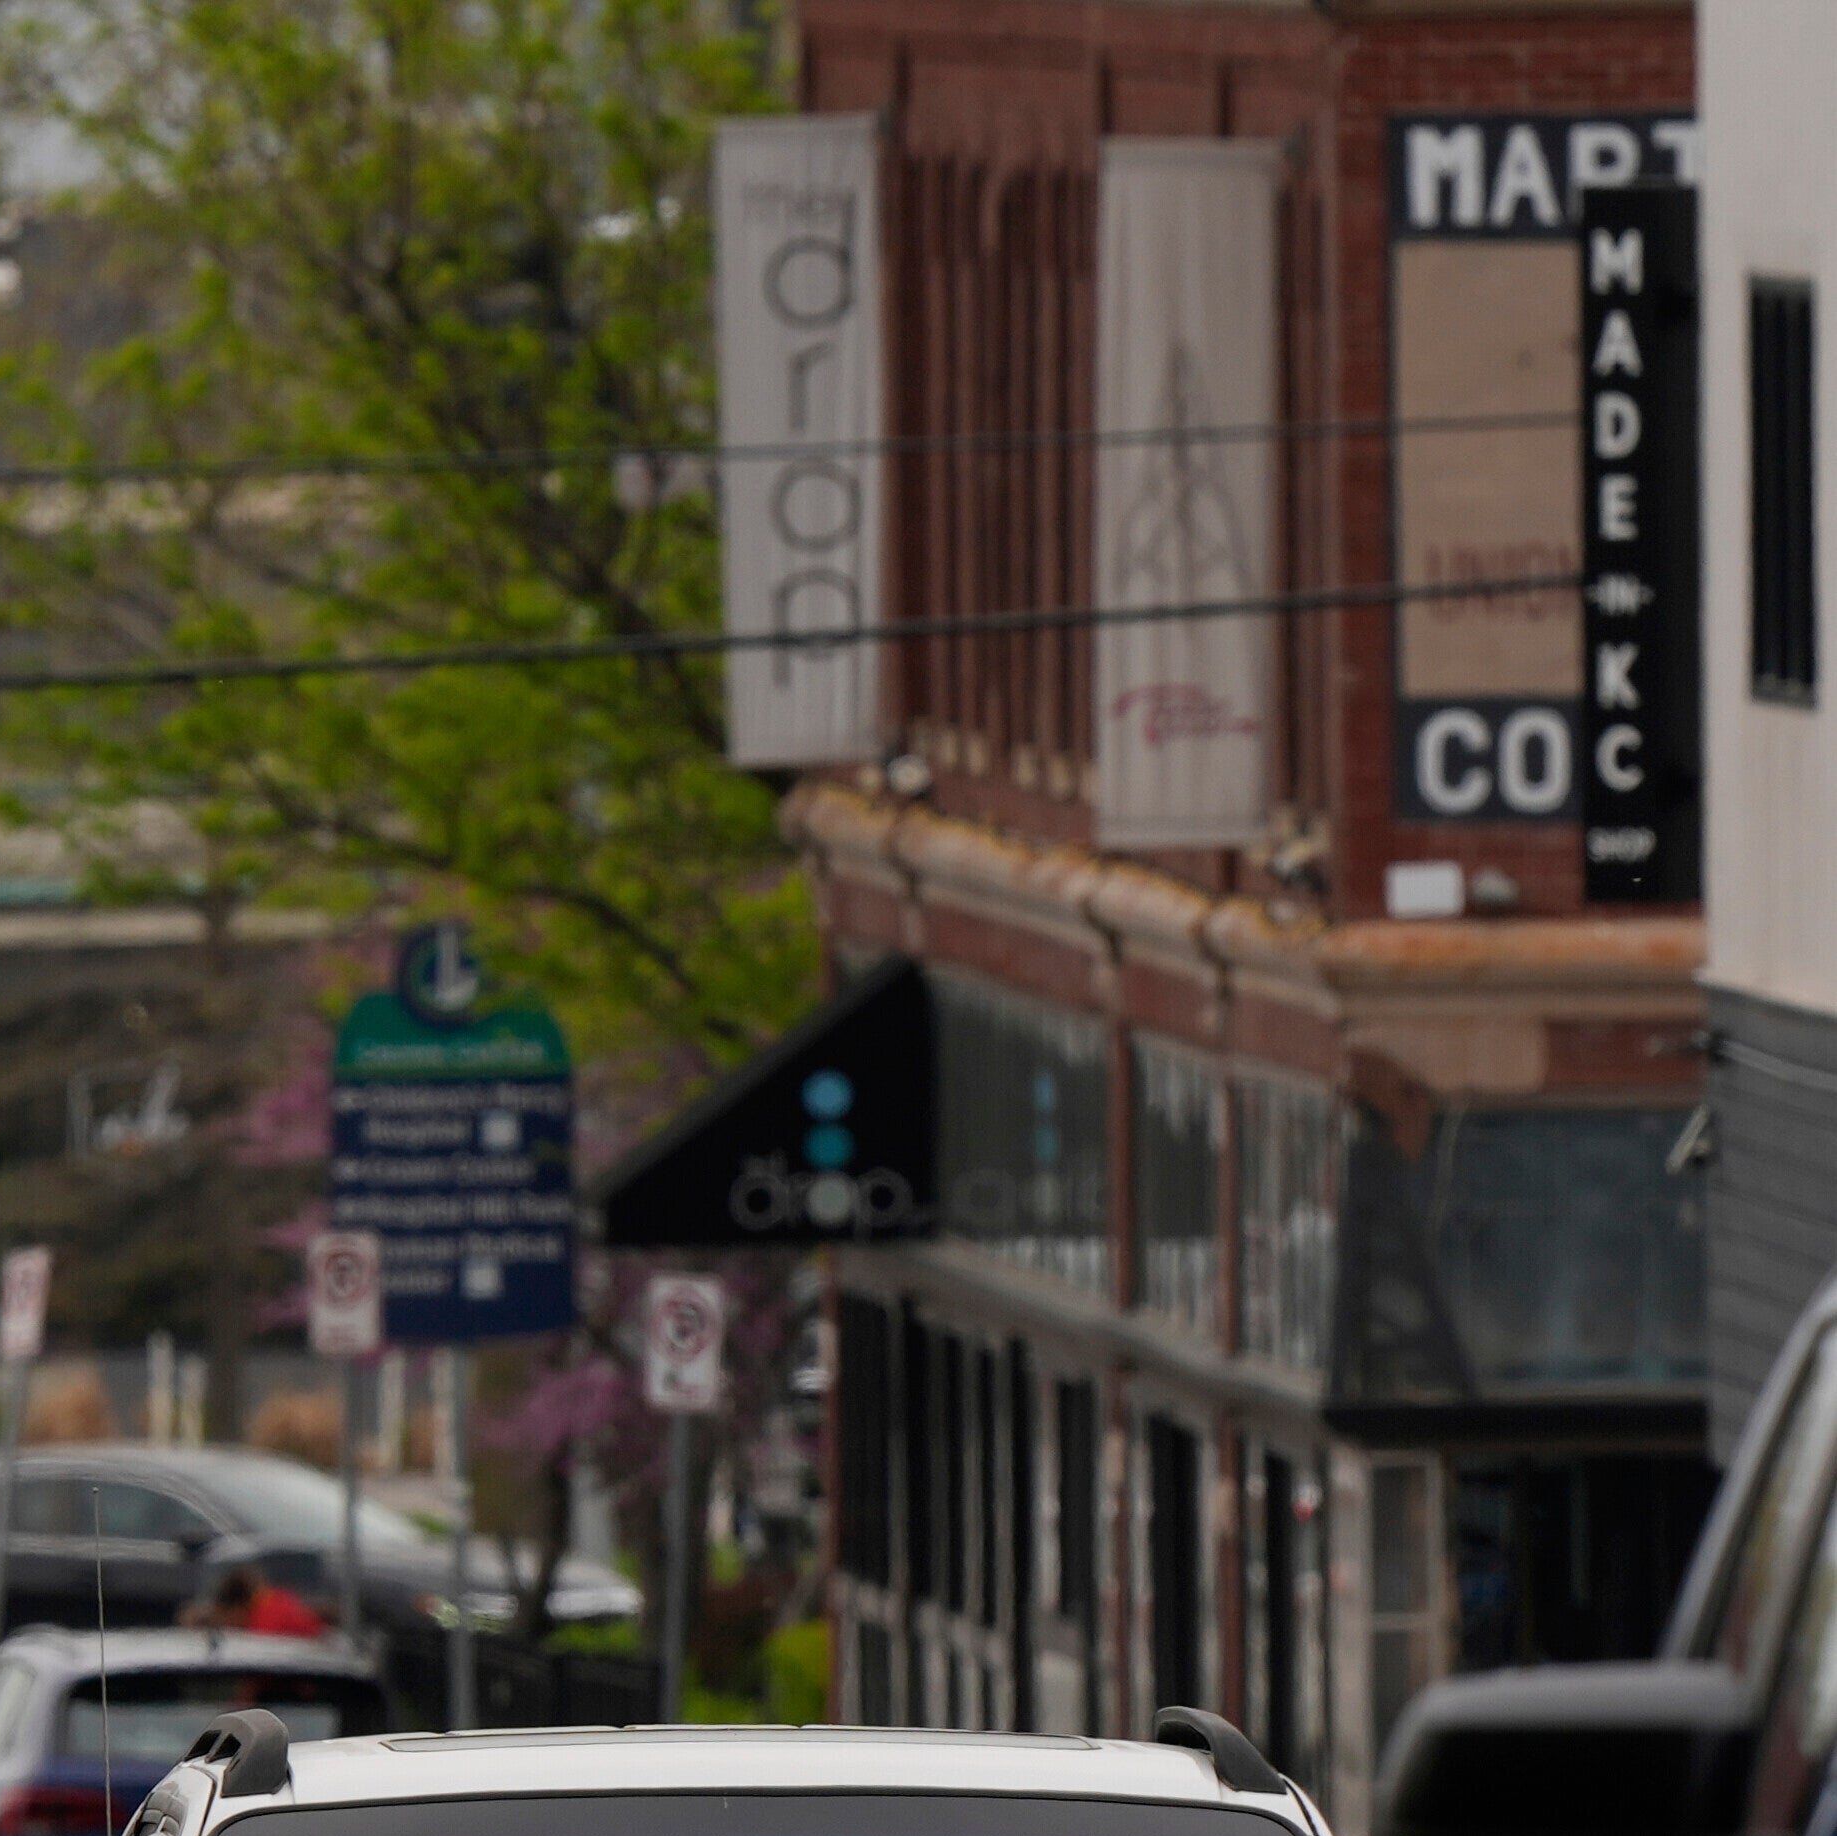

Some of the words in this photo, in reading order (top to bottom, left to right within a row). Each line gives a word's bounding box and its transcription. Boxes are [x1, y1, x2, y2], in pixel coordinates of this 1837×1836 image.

[1589, 227, 1644, 542] MADE
[1593, 641, 1646, 794] KC
[1586, 826, 1657, 863] SHOP
